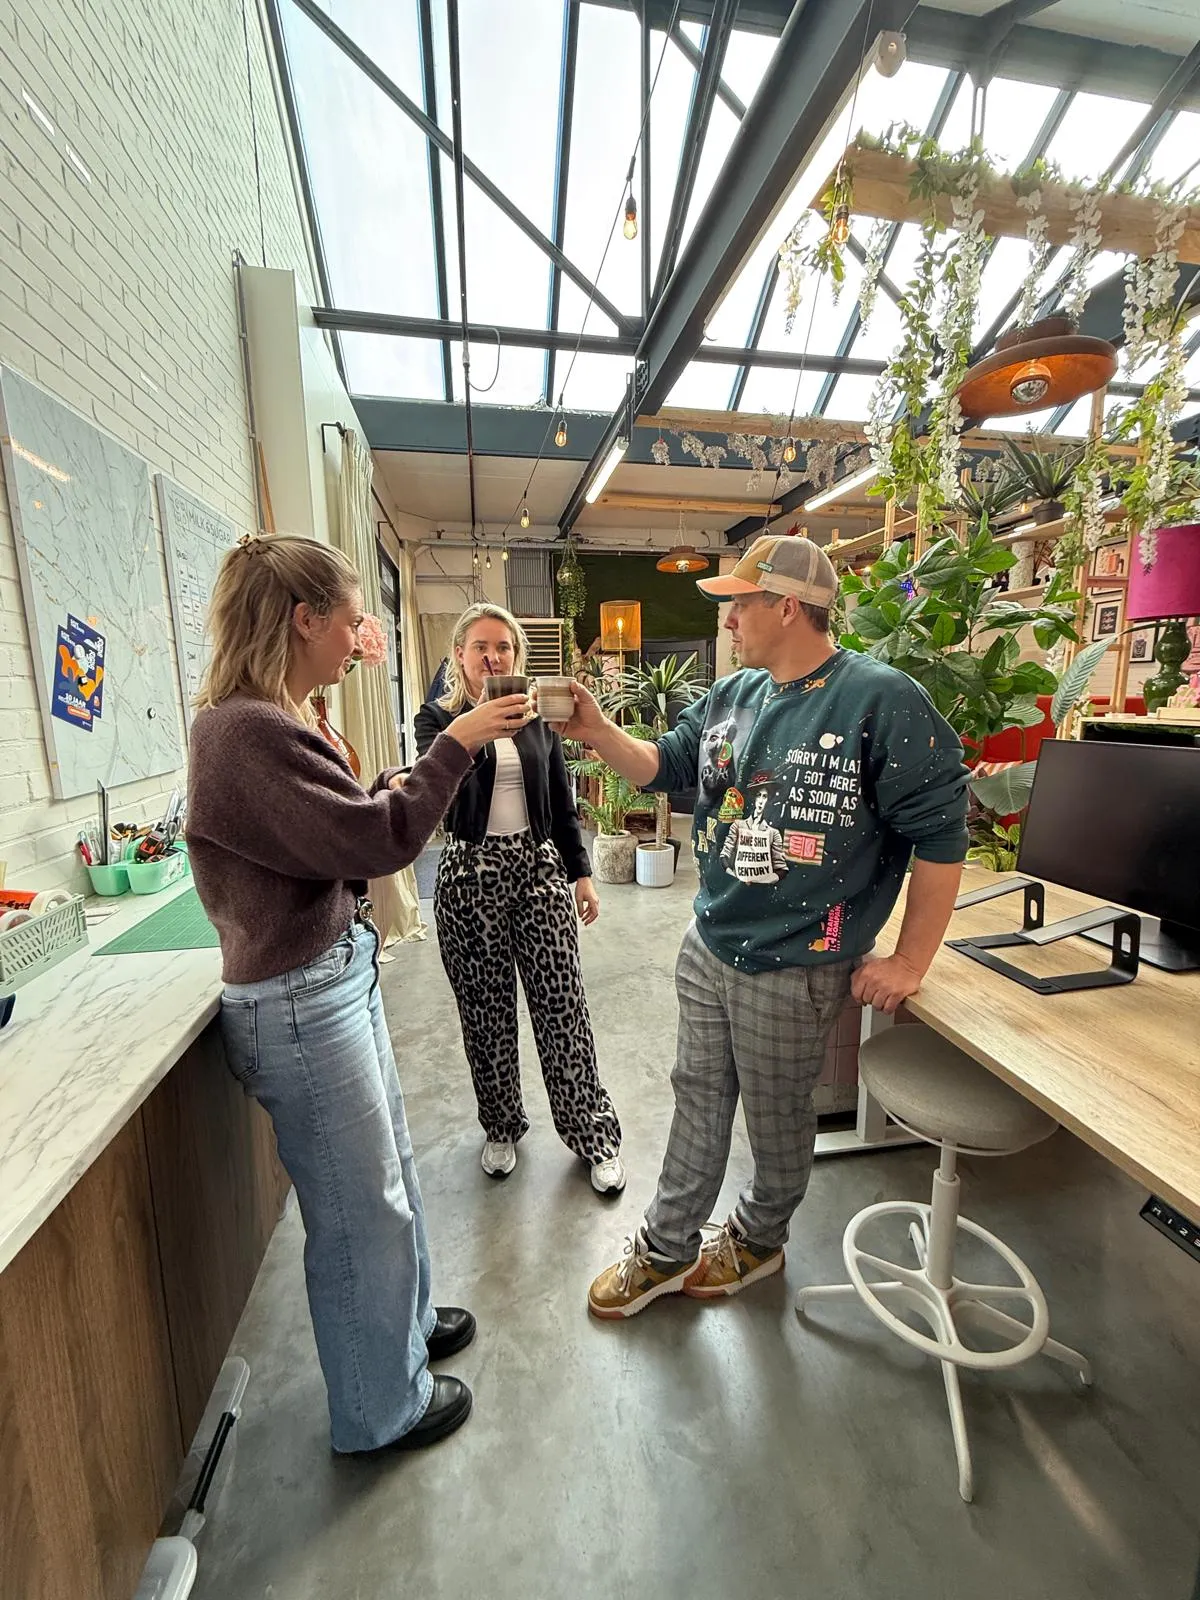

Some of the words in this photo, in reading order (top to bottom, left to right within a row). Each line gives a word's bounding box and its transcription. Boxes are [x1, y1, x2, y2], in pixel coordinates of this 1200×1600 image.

[785, 748, 818, 766] SORRY
[842, 758, 861, 774] LAT
[794, 768, 800, 782] I
[803, 770, 825, 786] GOT
[829, 775, 857, 792] HERE
[788, 786, 804, 802] AS
[808, 790, 837, 807] SOON
[841, 796, 857, 811] AS
[780, 803, 786, 818] I
[790, 805, 834, 825] WANTED
[740, 834, 753, 847] SAME
[754, 836, 767, 848] SHIT
[737, 851, 769, 862] DIFFERENT
[737, 866, 770, 877] CENTURY
[832, 903, 842, 938] COMPAN
